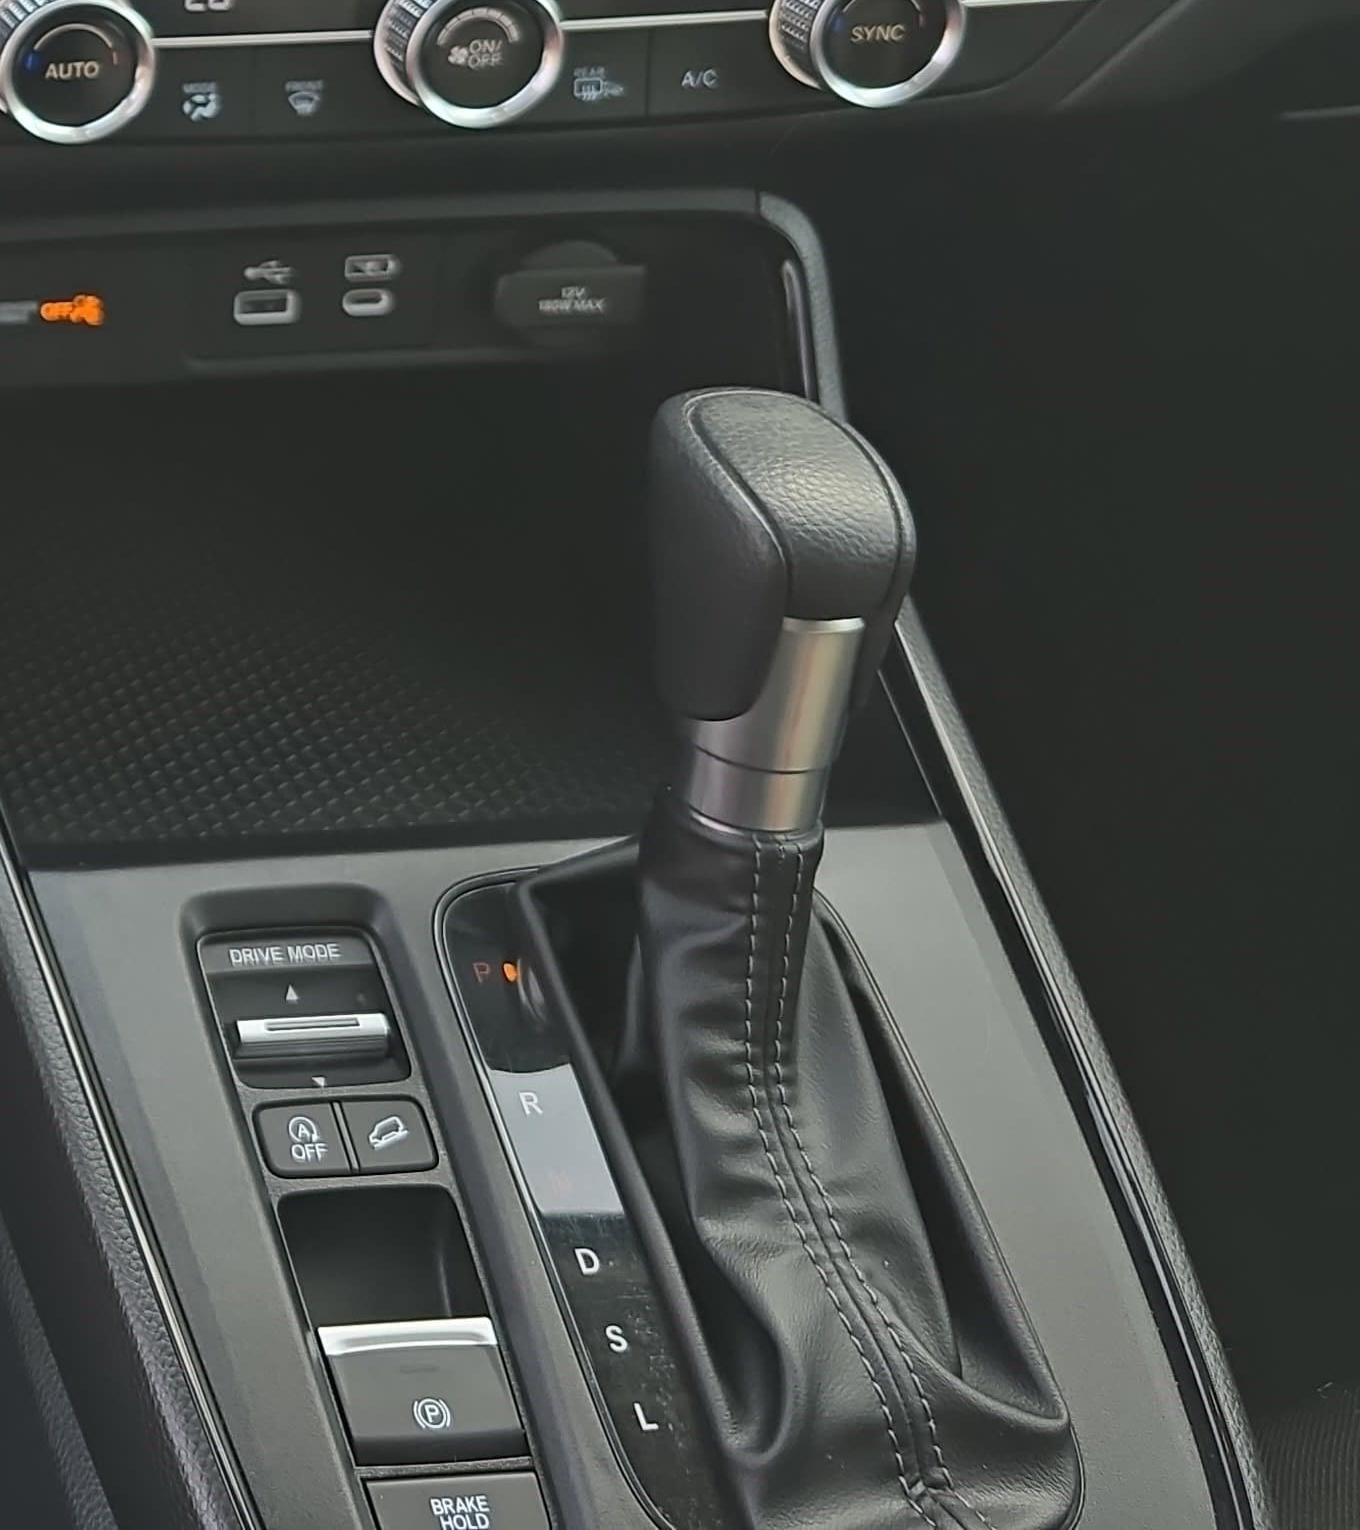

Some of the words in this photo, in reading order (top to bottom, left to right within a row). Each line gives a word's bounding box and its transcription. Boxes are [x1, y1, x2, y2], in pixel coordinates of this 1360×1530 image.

[850, 24, 906, 42] SYNC
[44, 60, 101, 81] AUTO
[468, 53, 503, 69] OFF
[681, 70, 718, 88] A/C
[573, 298, 605, 312] MAX
[229, 945, 285, 967] DRIVE
[288, 943, 341, 963] MODE
[473, 962, 489, 982] P
[519, 1091, 543, 1117] R
[290, 1141, 328, 1162] OFF
[574, 1248, 600, 1275] D
[605, 1325, 628, 1353] S
[632, 1403, 659, 1432] L
[429, 1495, 491, 1515] BRAKE
[439, 1511, 490, 1530] HOLD
